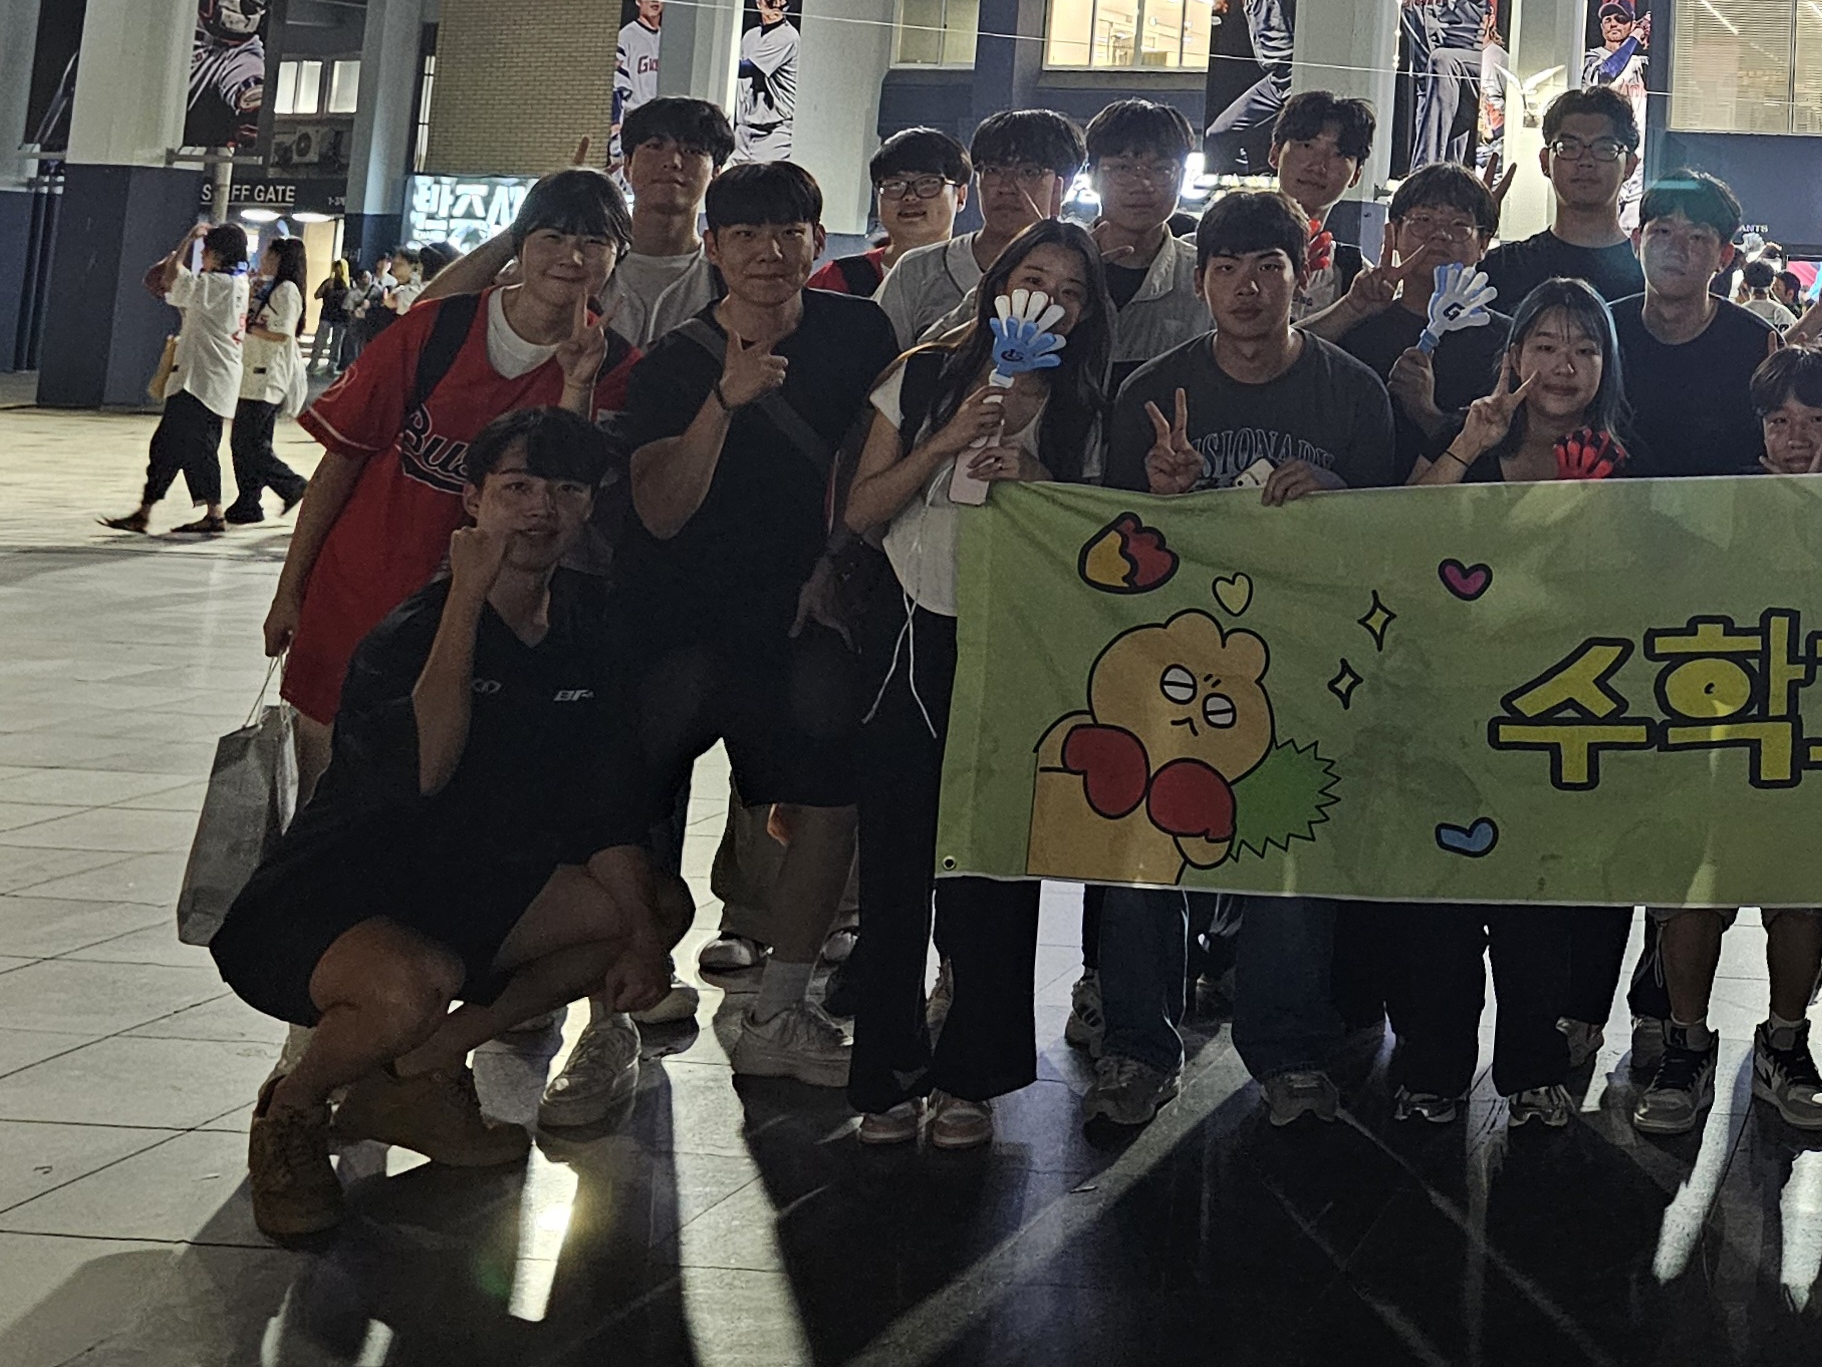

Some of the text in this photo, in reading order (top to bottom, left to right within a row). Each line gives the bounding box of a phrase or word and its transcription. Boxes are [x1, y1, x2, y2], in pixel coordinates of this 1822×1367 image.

[201, 184, 296, 202] SFF GATE
[1739, 224, 1768, 233] ANTS
